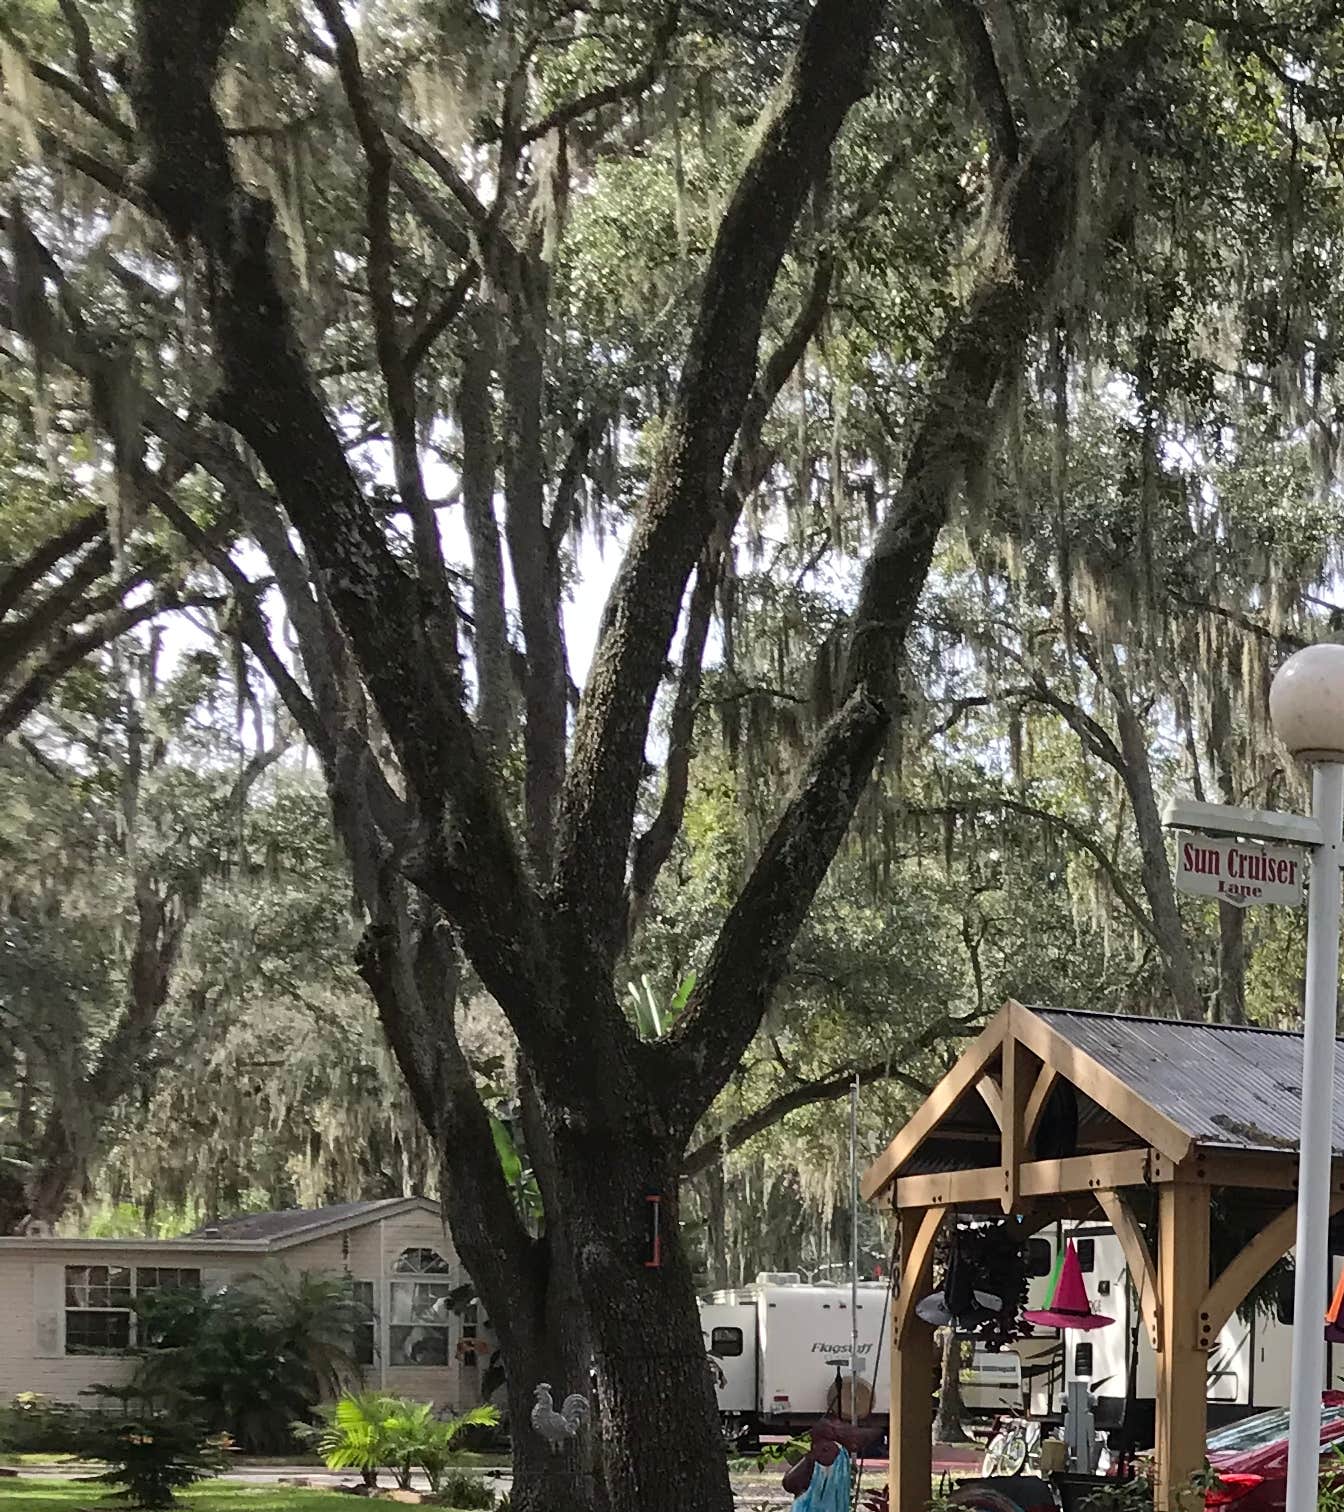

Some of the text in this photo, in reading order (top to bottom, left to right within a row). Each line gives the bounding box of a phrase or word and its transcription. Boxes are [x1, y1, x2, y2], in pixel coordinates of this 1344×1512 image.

[1183, 842, 1298, 885] Sun Cruiser
[1218, 880, 1262, 897] Lane
